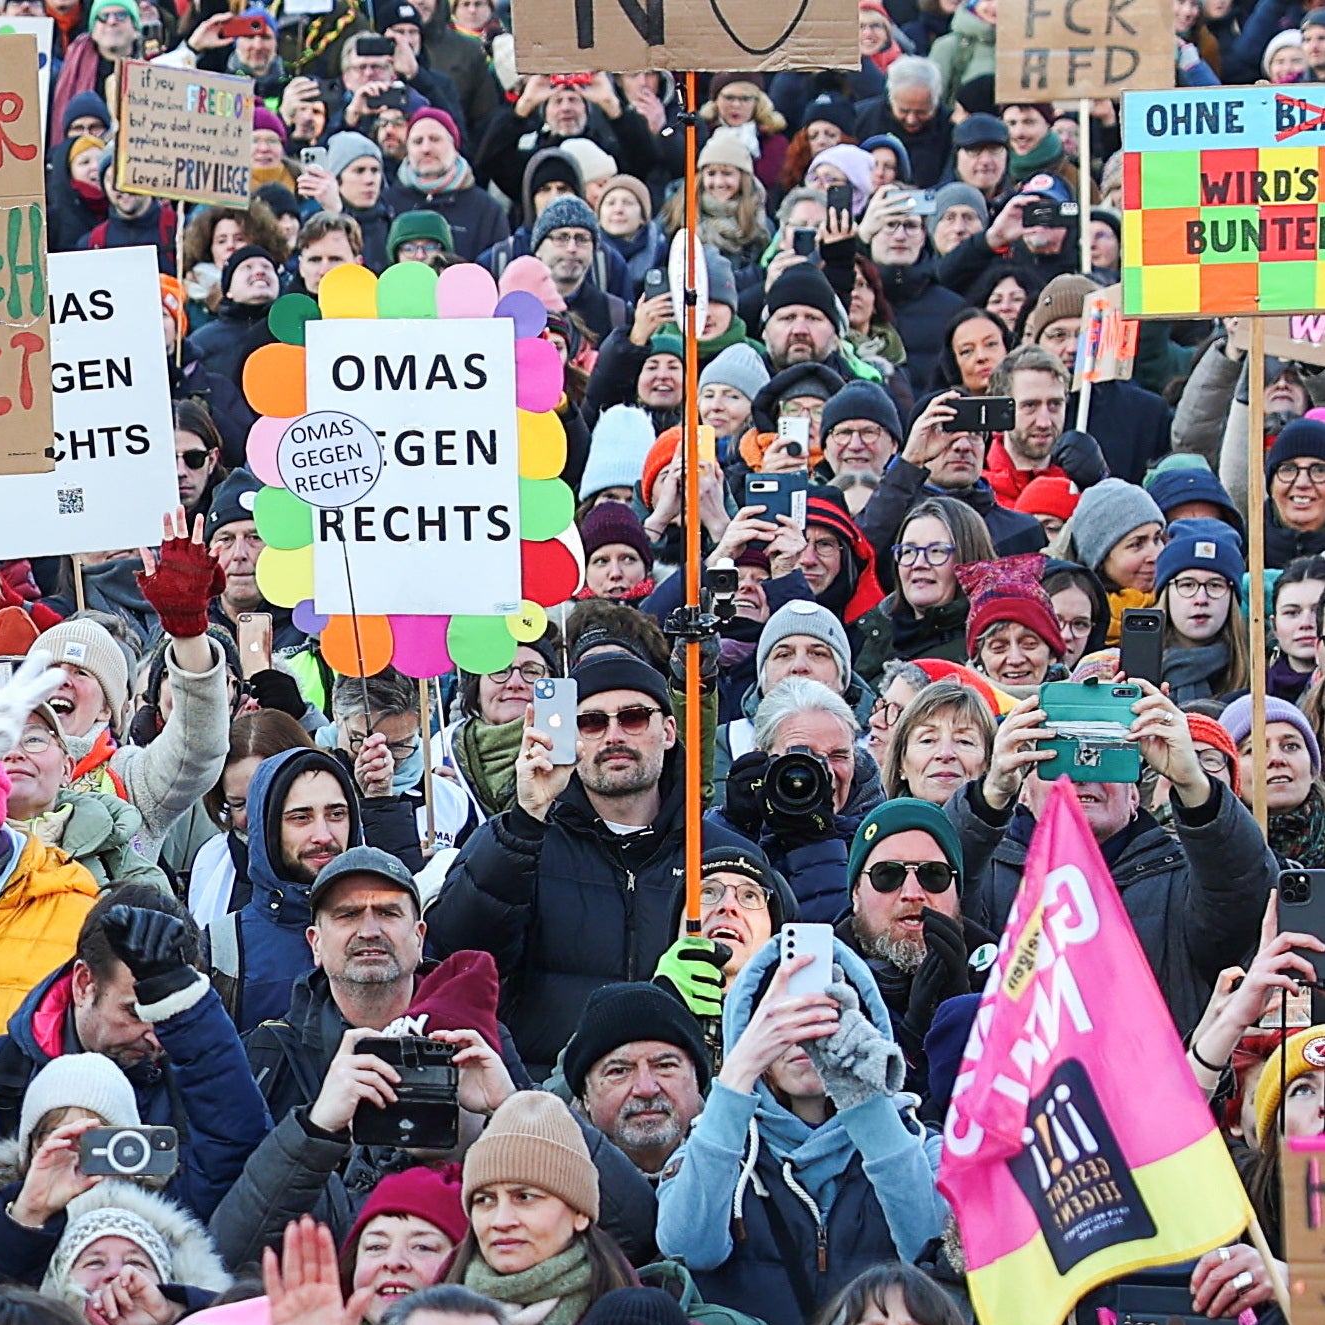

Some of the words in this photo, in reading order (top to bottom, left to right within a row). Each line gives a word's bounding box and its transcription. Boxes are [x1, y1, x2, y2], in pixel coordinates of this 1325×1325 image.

[1020, 45, 1141, 90] AFD
[1145, 100, 1245, 138] OHNE
[331, 353, 488, 392] OMAS
[290, 418, 355, 444] OMAS
[291, 442, 364, 469] GEGEN
[295, 465, 374, 494] RECHTS
[319, 504, 512, 543] RECHTS
